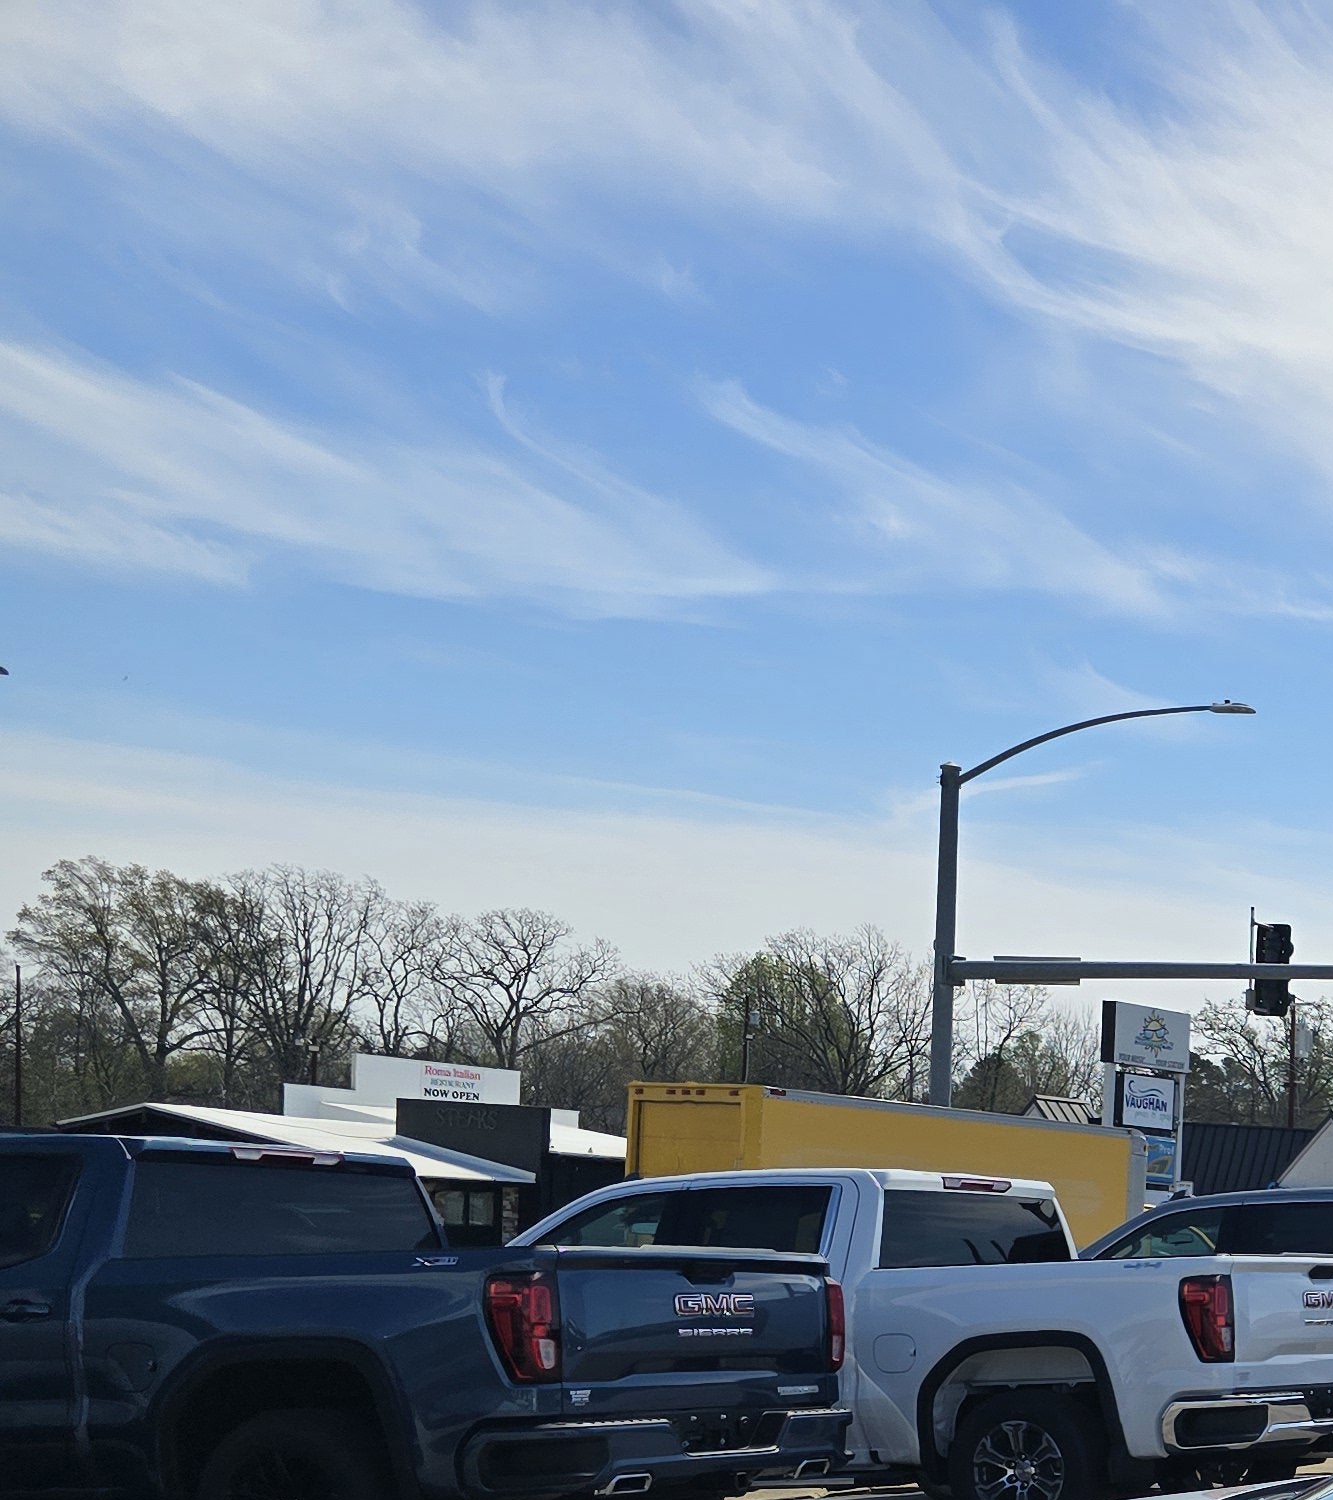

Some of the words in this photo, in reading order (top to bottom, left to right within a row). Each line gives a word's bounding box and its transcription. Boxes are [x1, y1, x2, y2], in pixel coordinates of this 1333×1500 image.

[424, 1065, 451, 1077] Roma
[453, 1068, 481, 1080] Italian
[423, 1087, 450, 1098] NOW
[452, 1091, 480, 1101] OPEN
[1125, 1094, 1168, 1113] VAUGHAN
[675, 1293, 755, 1318] GMC
[678, 1328, 753, 1338] SIERRA
